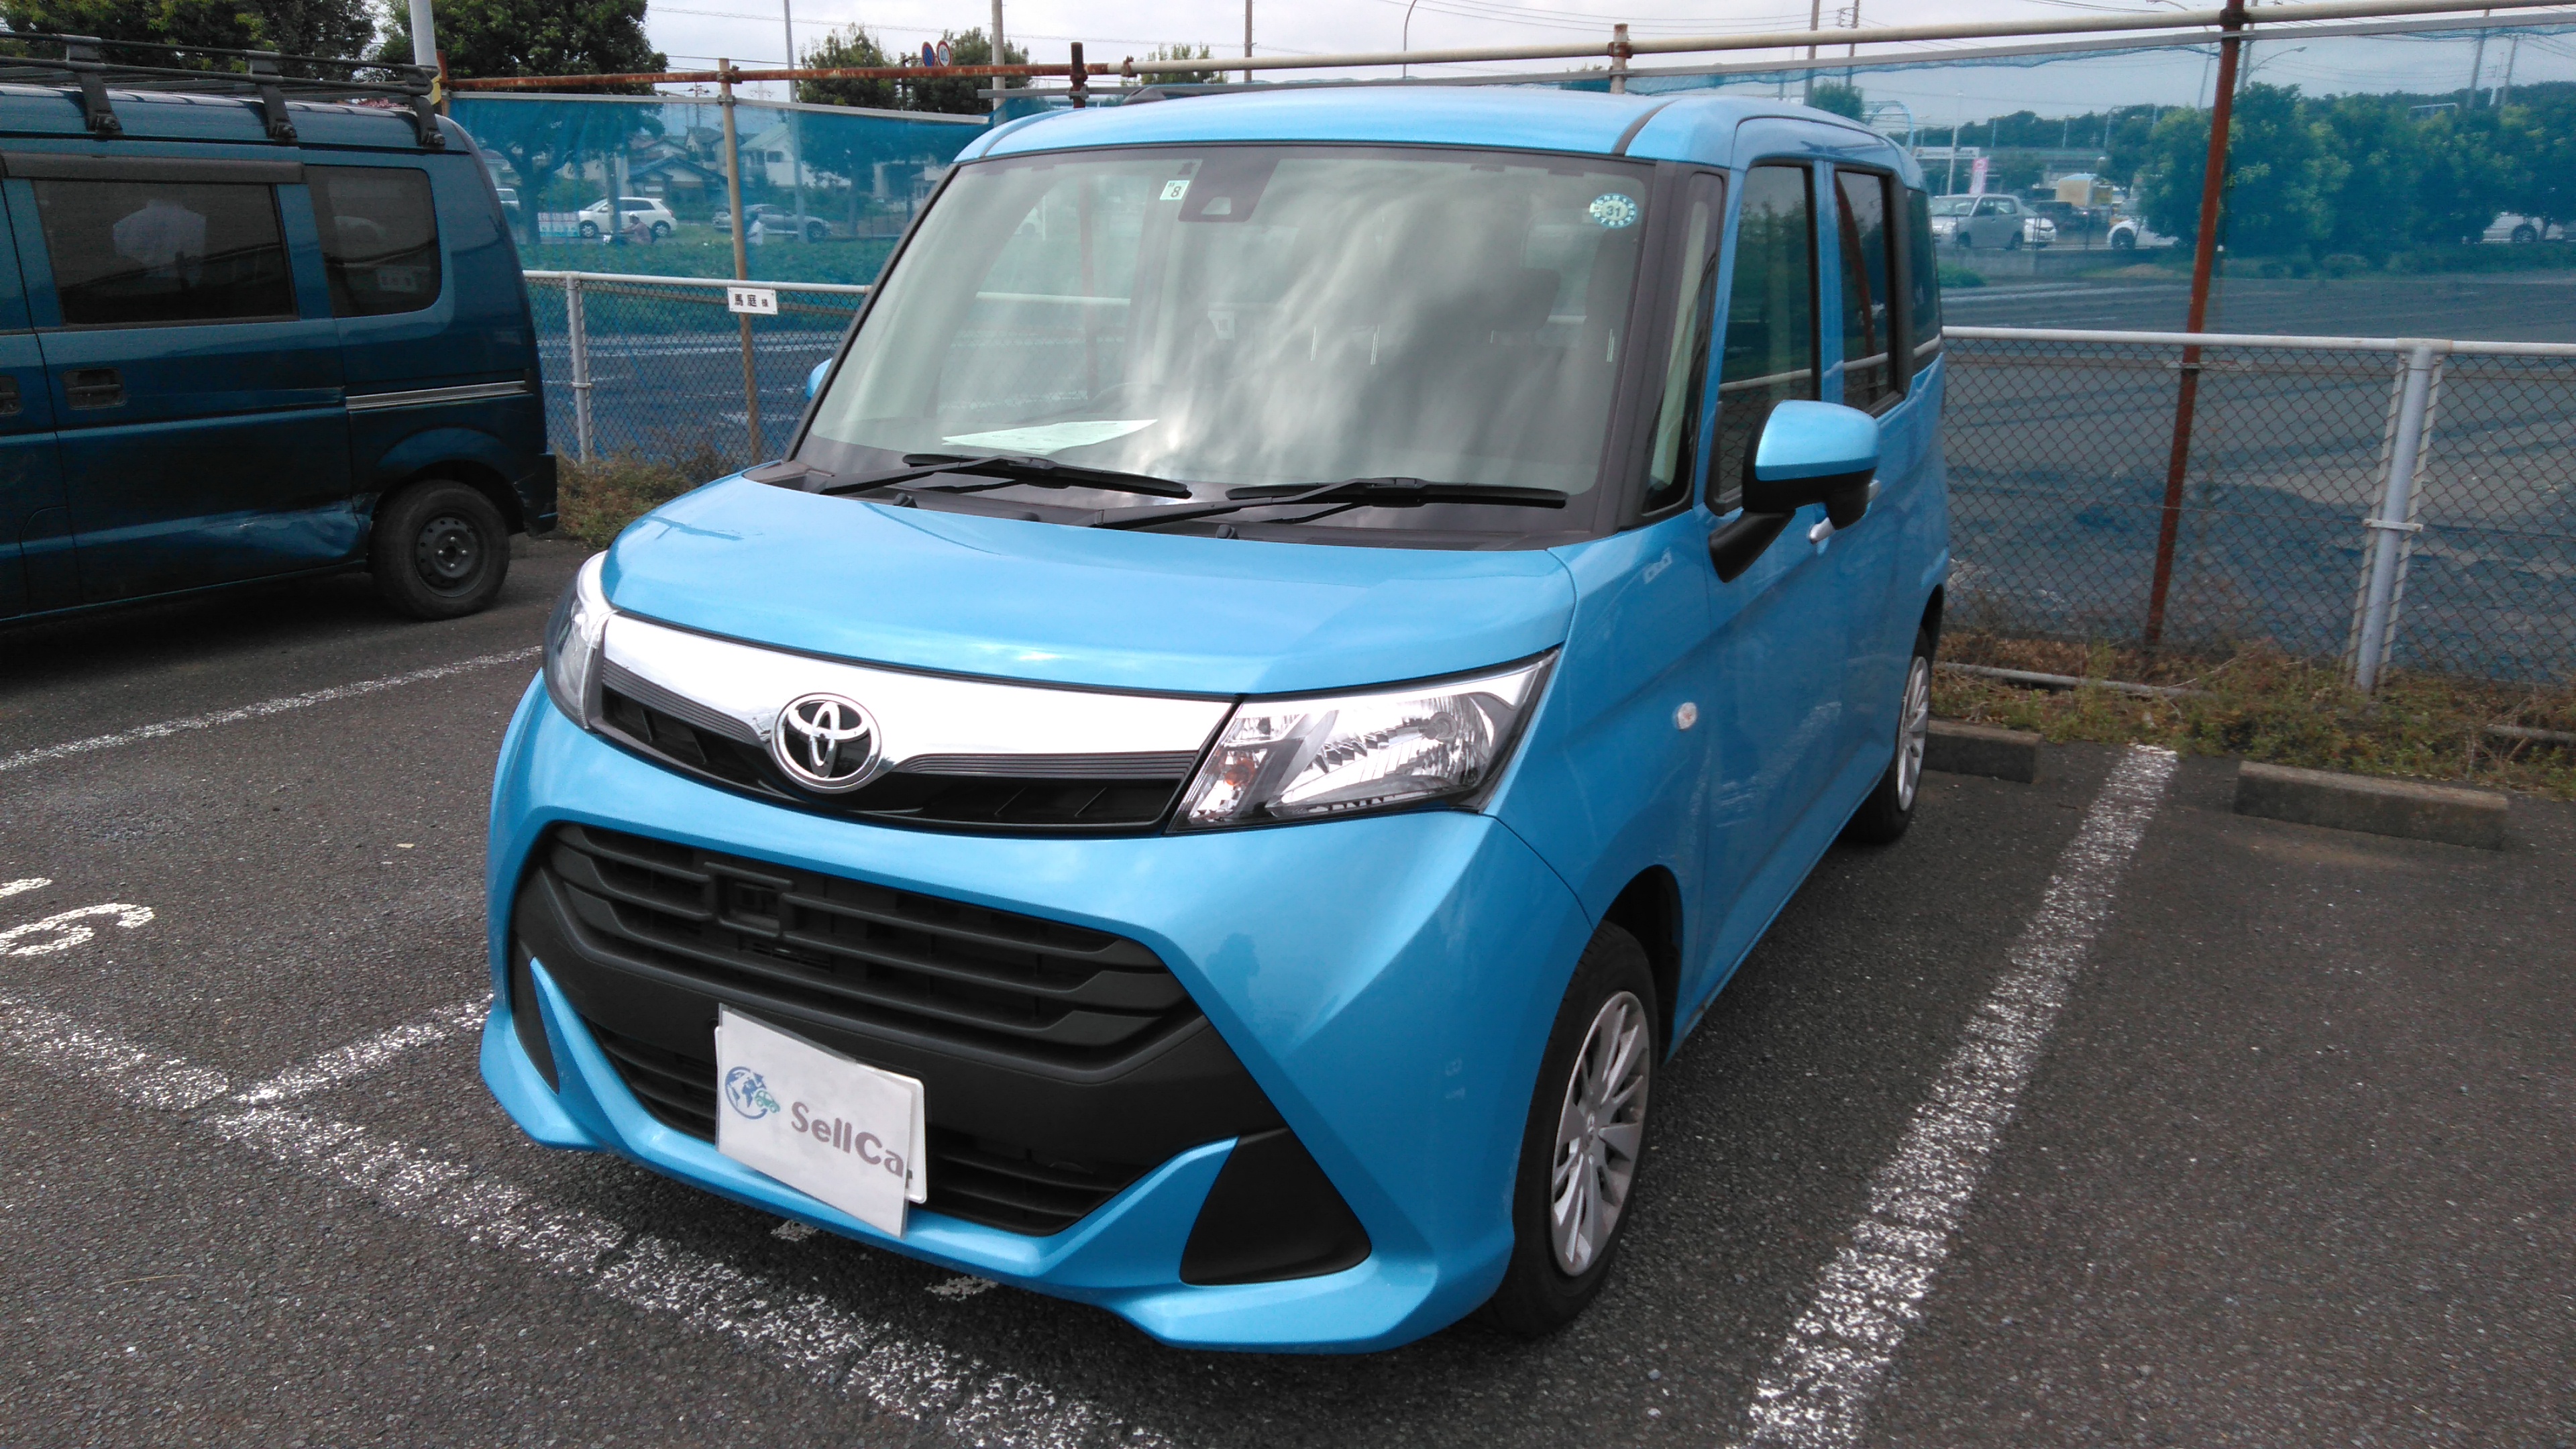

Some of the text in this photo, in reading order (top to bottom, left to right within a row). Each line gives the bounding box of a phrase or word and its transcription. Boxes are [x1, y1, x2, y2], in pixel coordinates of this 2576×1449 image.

[1171, 186, 1181, 198] 8
[1607, 205, 1621, 217] 31
[791, 1101, 904, 1178] SellCa
